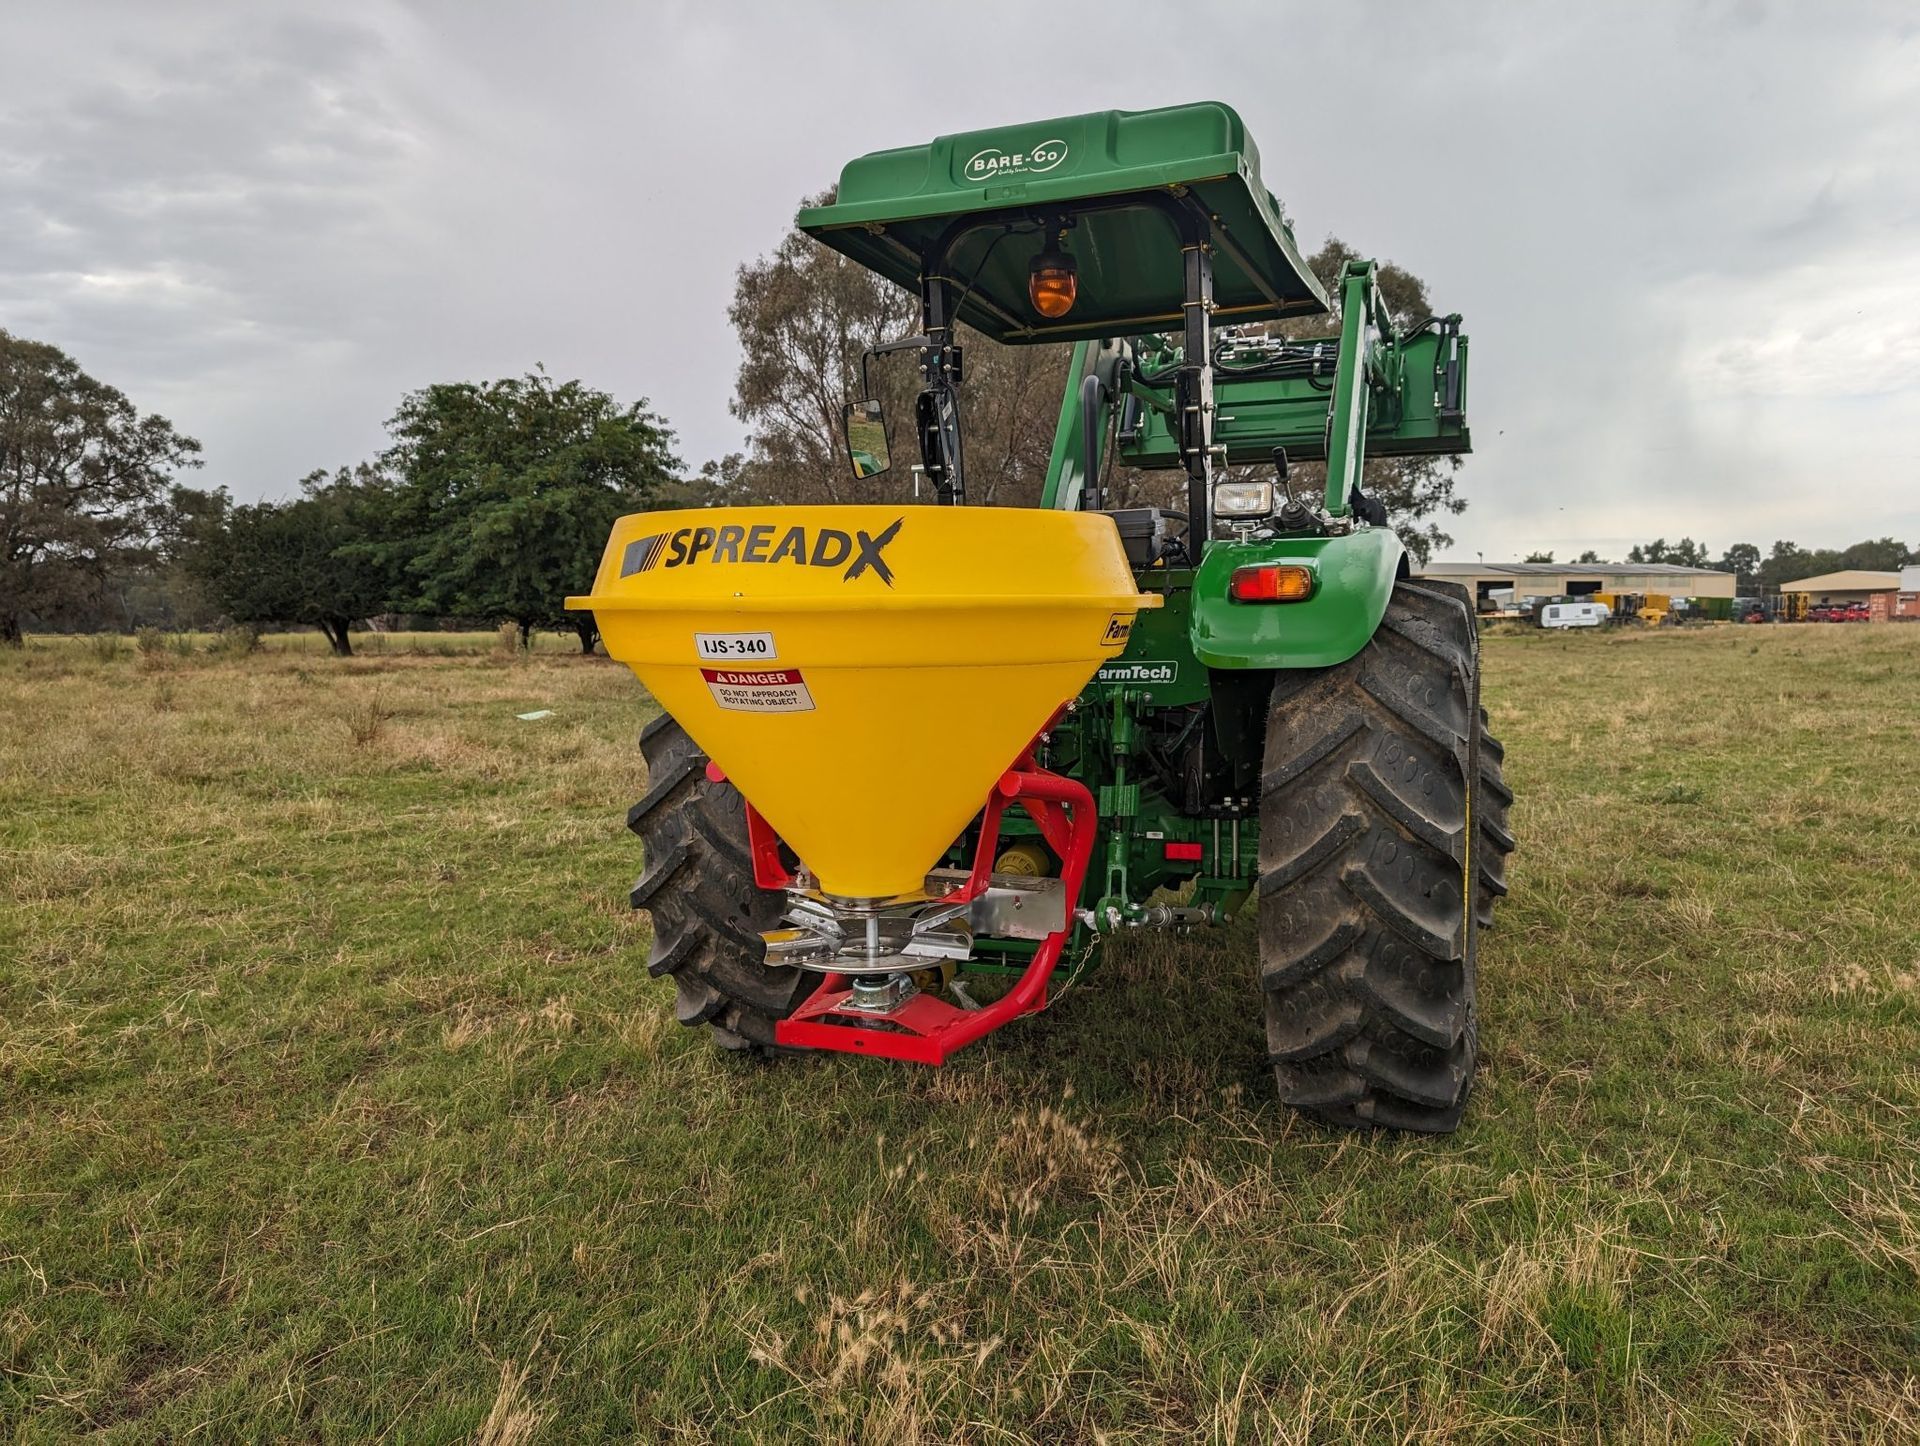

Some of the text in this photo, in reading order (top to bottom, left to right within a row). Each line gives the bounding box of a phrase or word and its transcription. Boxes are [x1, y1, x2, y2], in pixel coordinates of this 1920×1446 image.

[665, 516, 905, 590] SPREADX
[703, 639, 766, 654] IJS-340
[1098, 665, 1171, 679] armTech
[728, 673, 788, 684] DANGER
[752, 690, 797, 698] APPROACH
[724, 696, 764, 706] ROTATING
